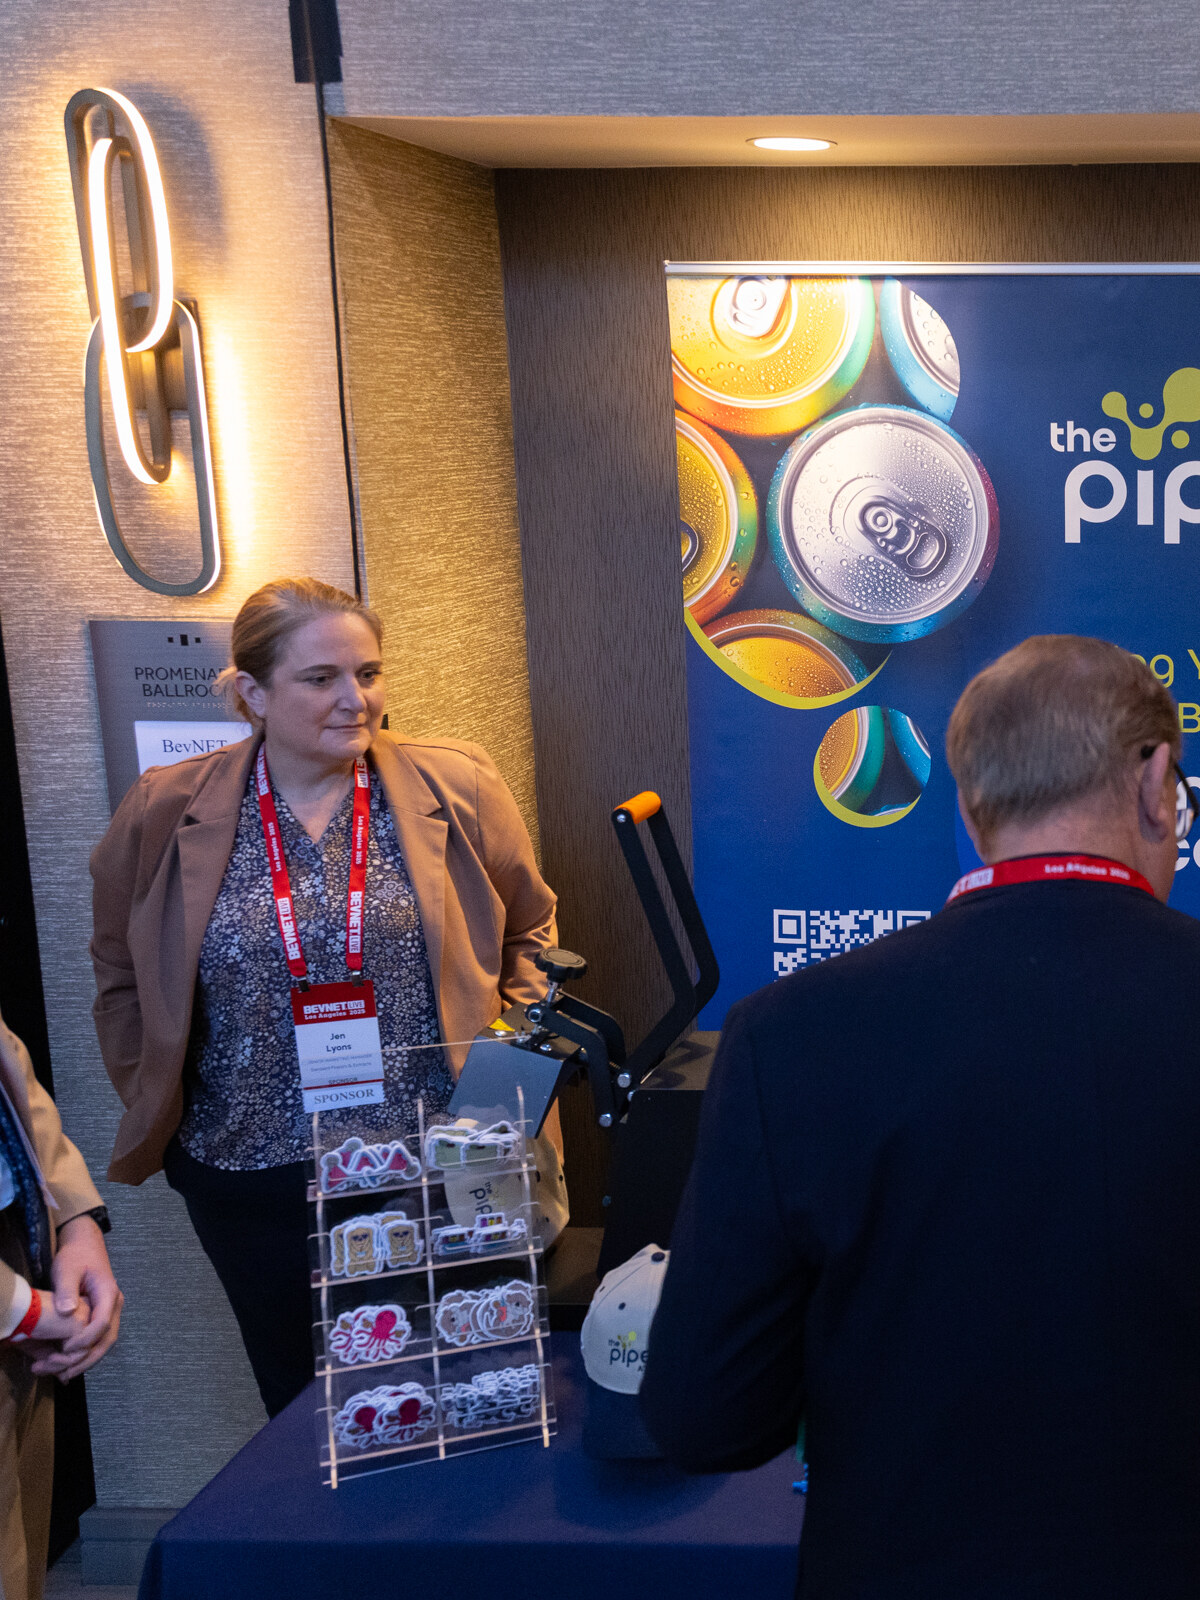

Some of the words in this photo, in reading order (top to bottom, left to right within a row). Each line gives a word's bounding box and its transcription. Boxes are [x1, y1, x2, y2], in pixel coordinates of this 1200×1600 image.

[1050, 420, 1116, 452] the
[271, 837, 281, 861] Angeles
[1044, 863, 1064, 874] Los
[1066, 862, 1108, 876] Angeles
[318, 1011, 347, 1019] Angeles
[349, 1008, 366, 1016] 2025
[329, 1032, 346, 1041] Jen
[326, 1043, 352, 1054] Lyons
[314, 1088, 375, 1105] SPONSOR
[484, 1181, 493, 1195] the
[607, 1338, 621, 1347] the
[609, 1348, 649, 1368] pipe
